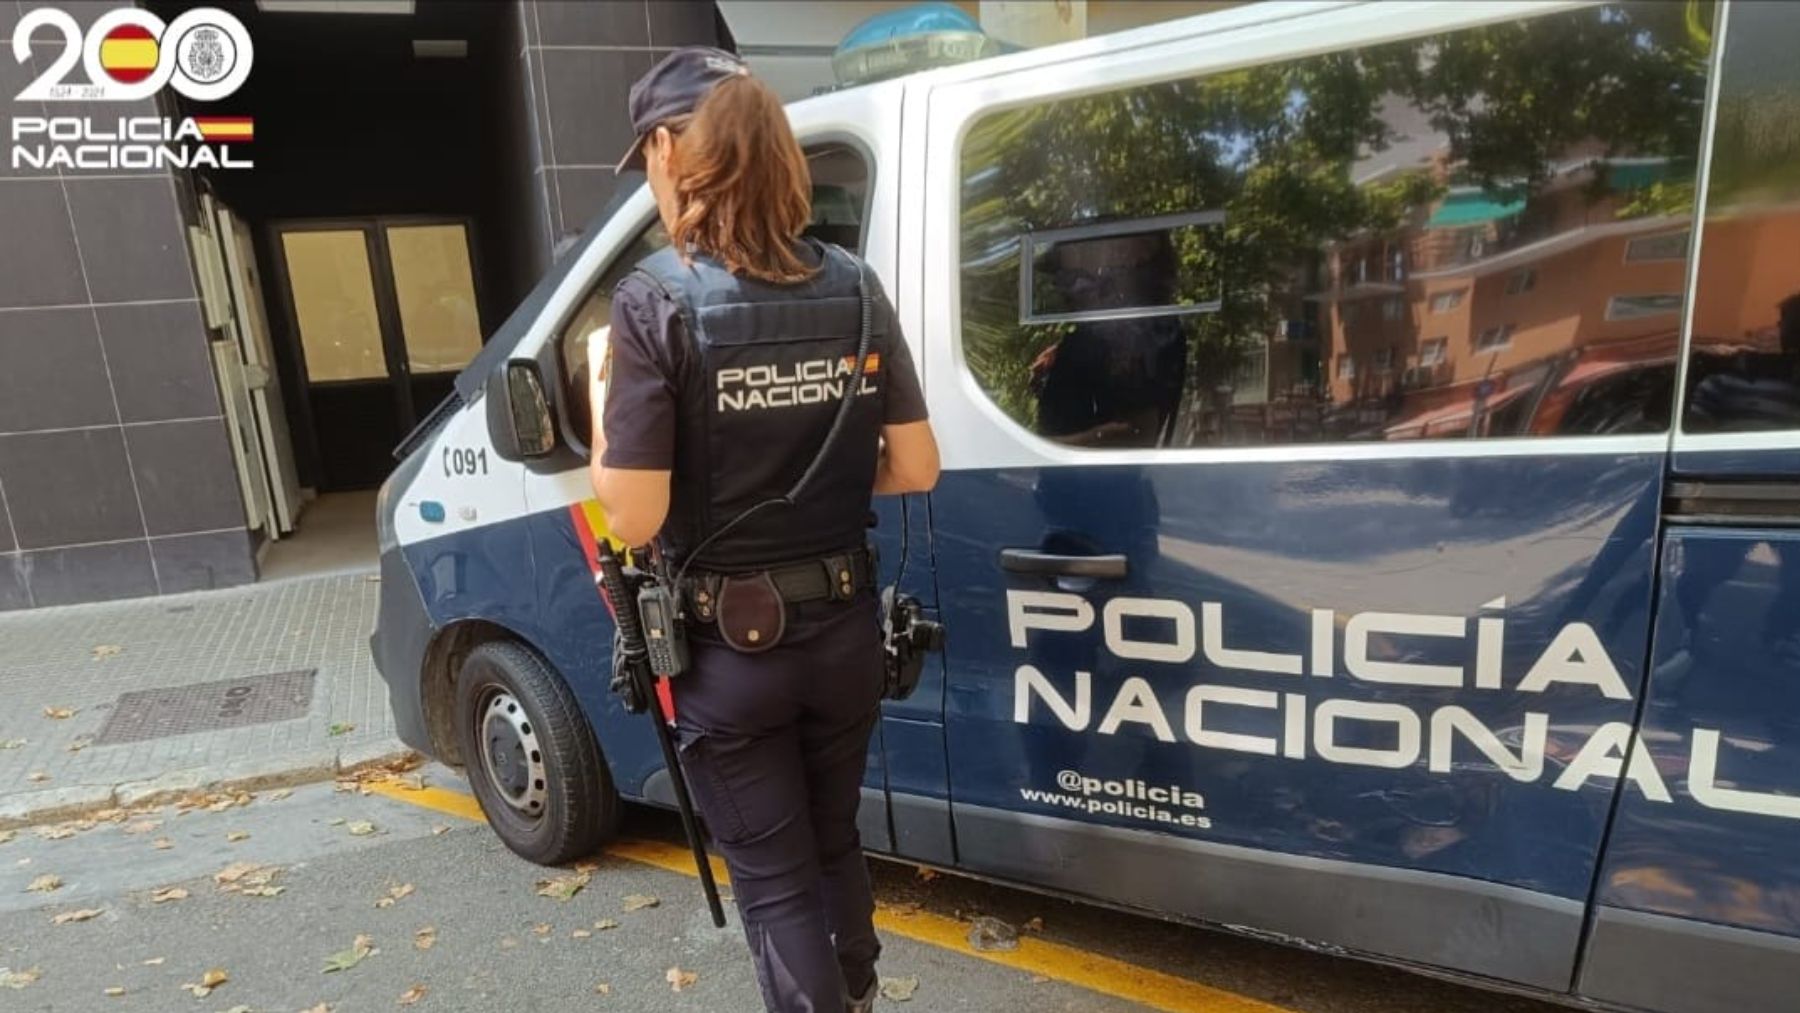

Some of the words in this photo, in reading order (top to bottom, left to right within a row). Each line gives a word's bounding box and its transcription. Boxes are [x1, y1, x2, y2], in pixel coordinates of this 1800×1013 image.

[717, 357, 852, 389] POLICIA
[718, 376, 878, 412] NACIONL
[452, 447, 488, 475] 091
[1006, 588, 1634, 700] POLICÍA
[1014, 664, 1800, 819] NACIONAL
[1020, 788, 1212, 829] www.policia.es
[1056, 769, 1205, 809] @policia
